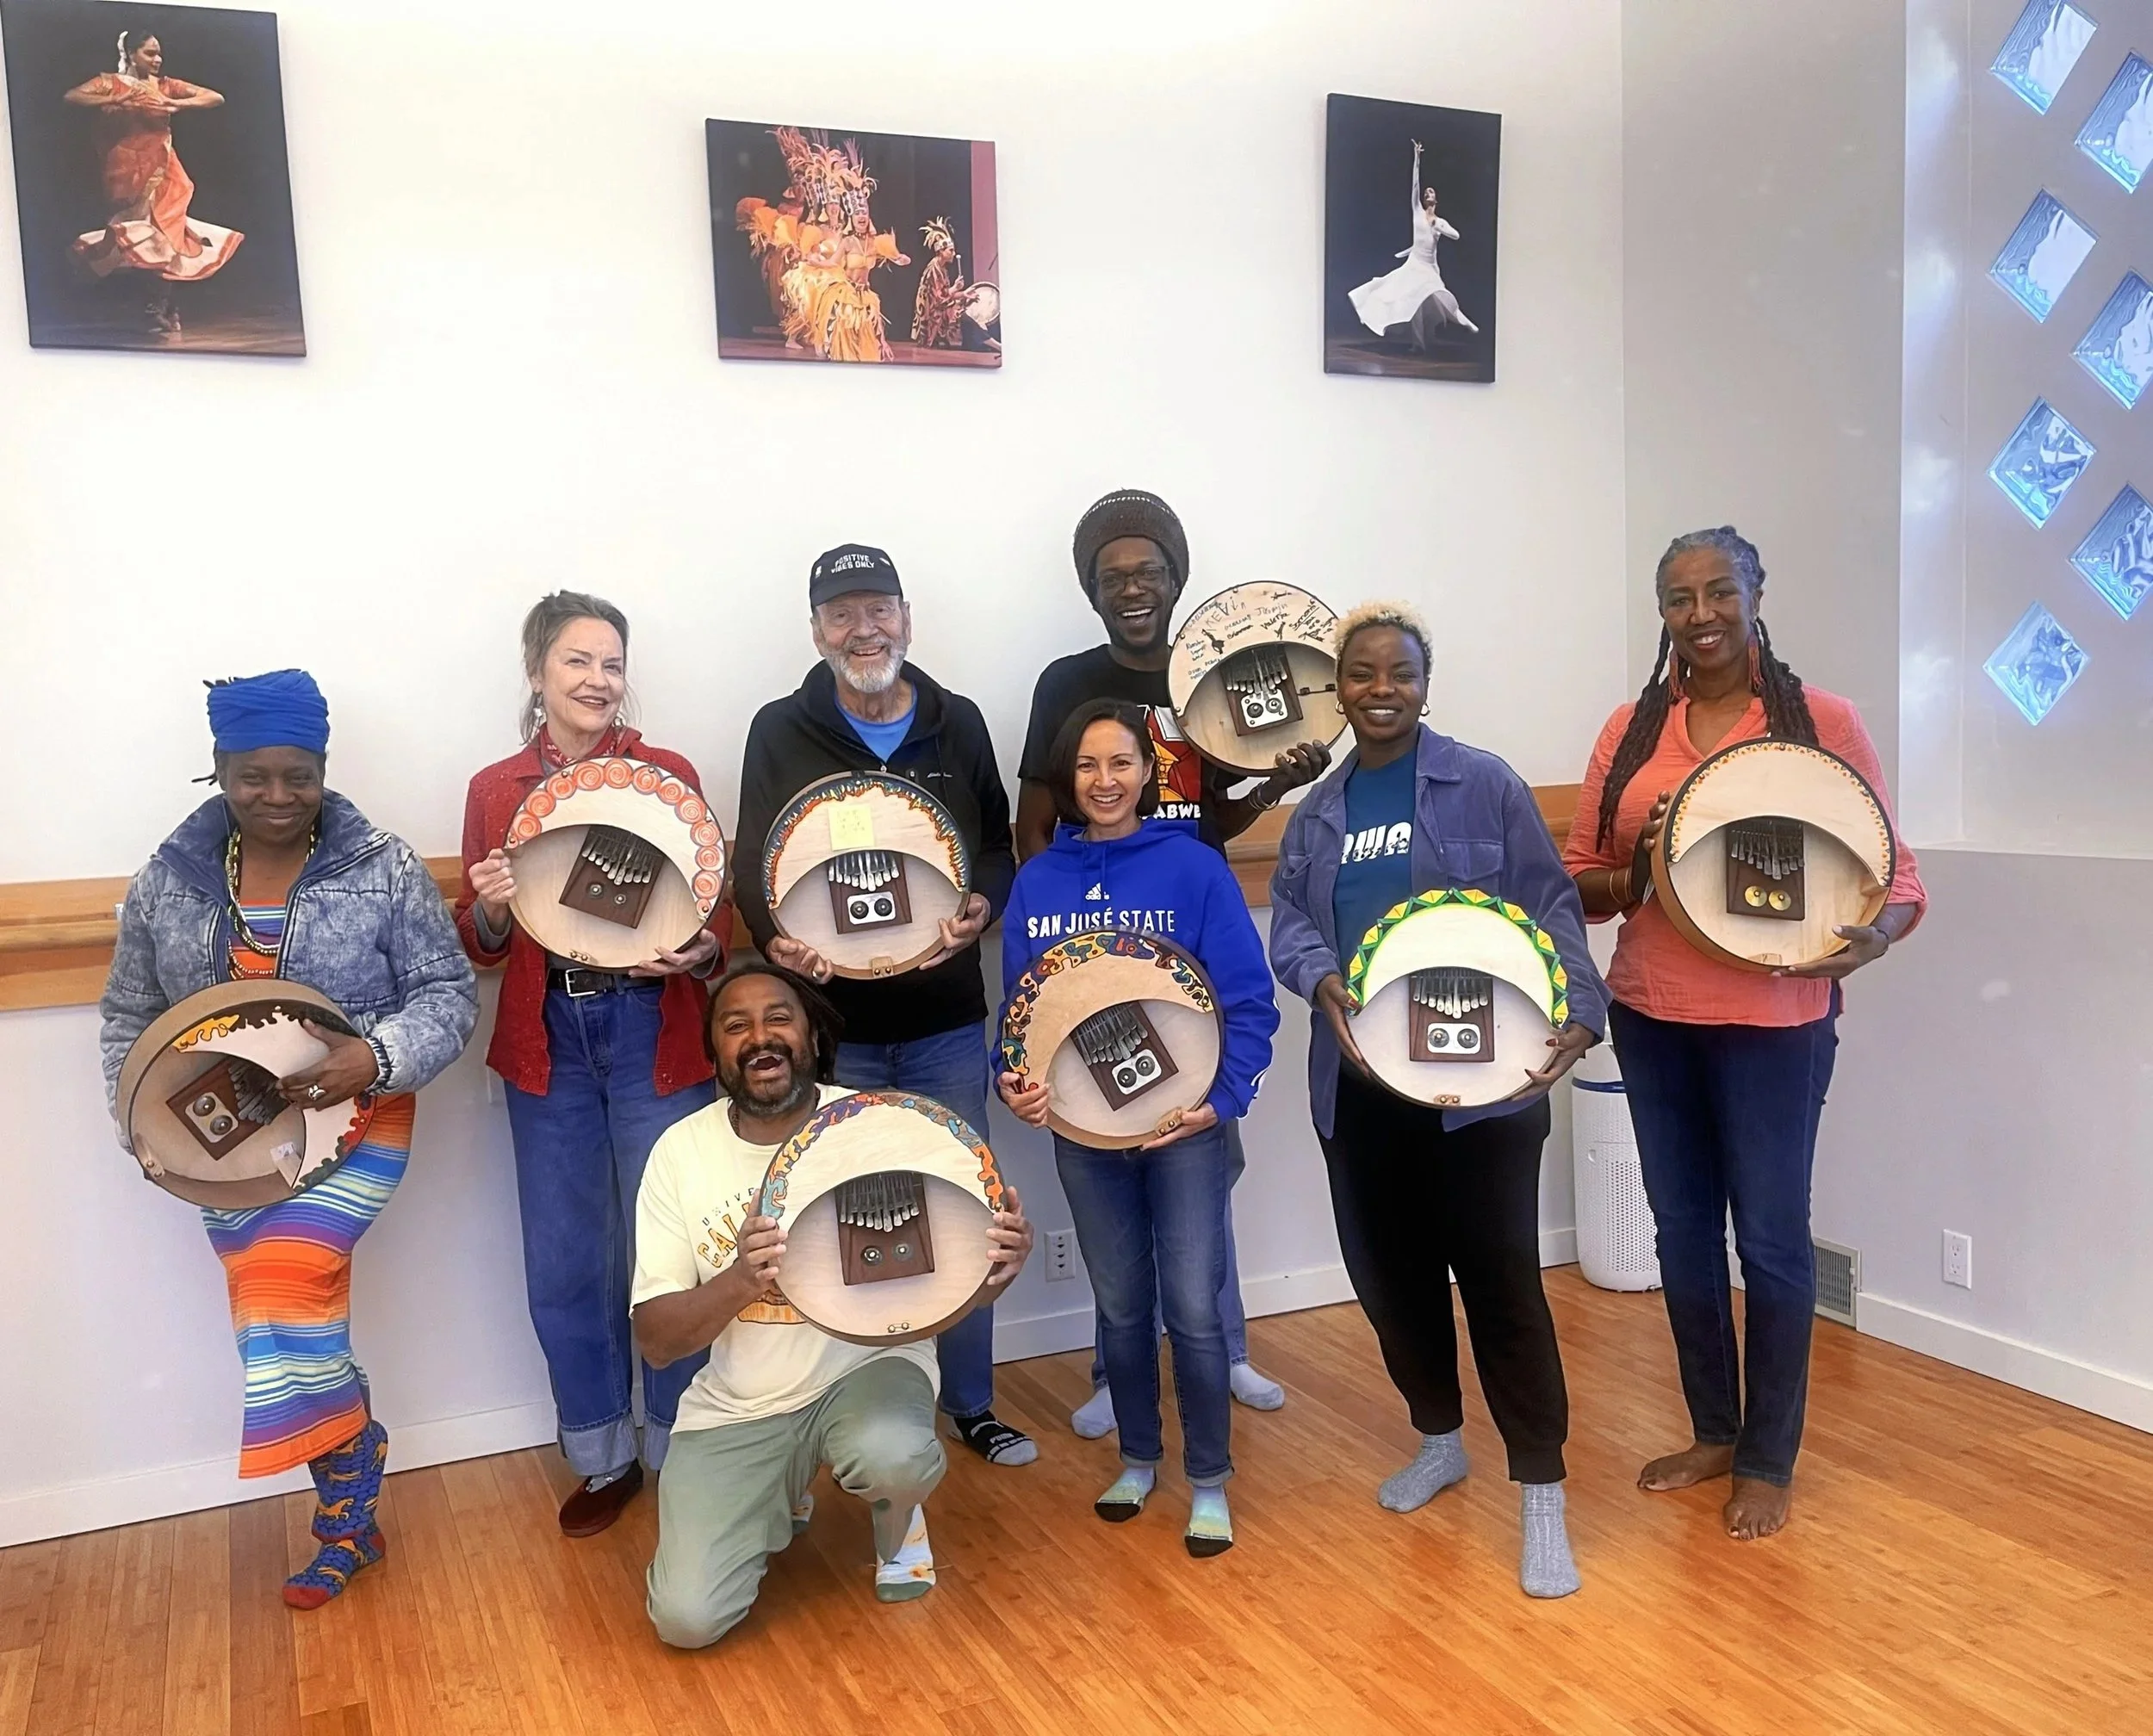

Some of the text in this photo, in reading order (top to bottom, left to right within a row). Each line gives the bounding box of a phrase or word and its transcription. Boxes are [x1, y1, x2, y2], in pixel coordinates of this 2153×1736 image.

[830, 560, 875, 574] VIBES ONLY
[835, 554, 870, 567] POSITIVE
[1139, 803, 1201, 819] ABWE
[1027, 907, 1175, 939] SAN JOSÉ STATE
